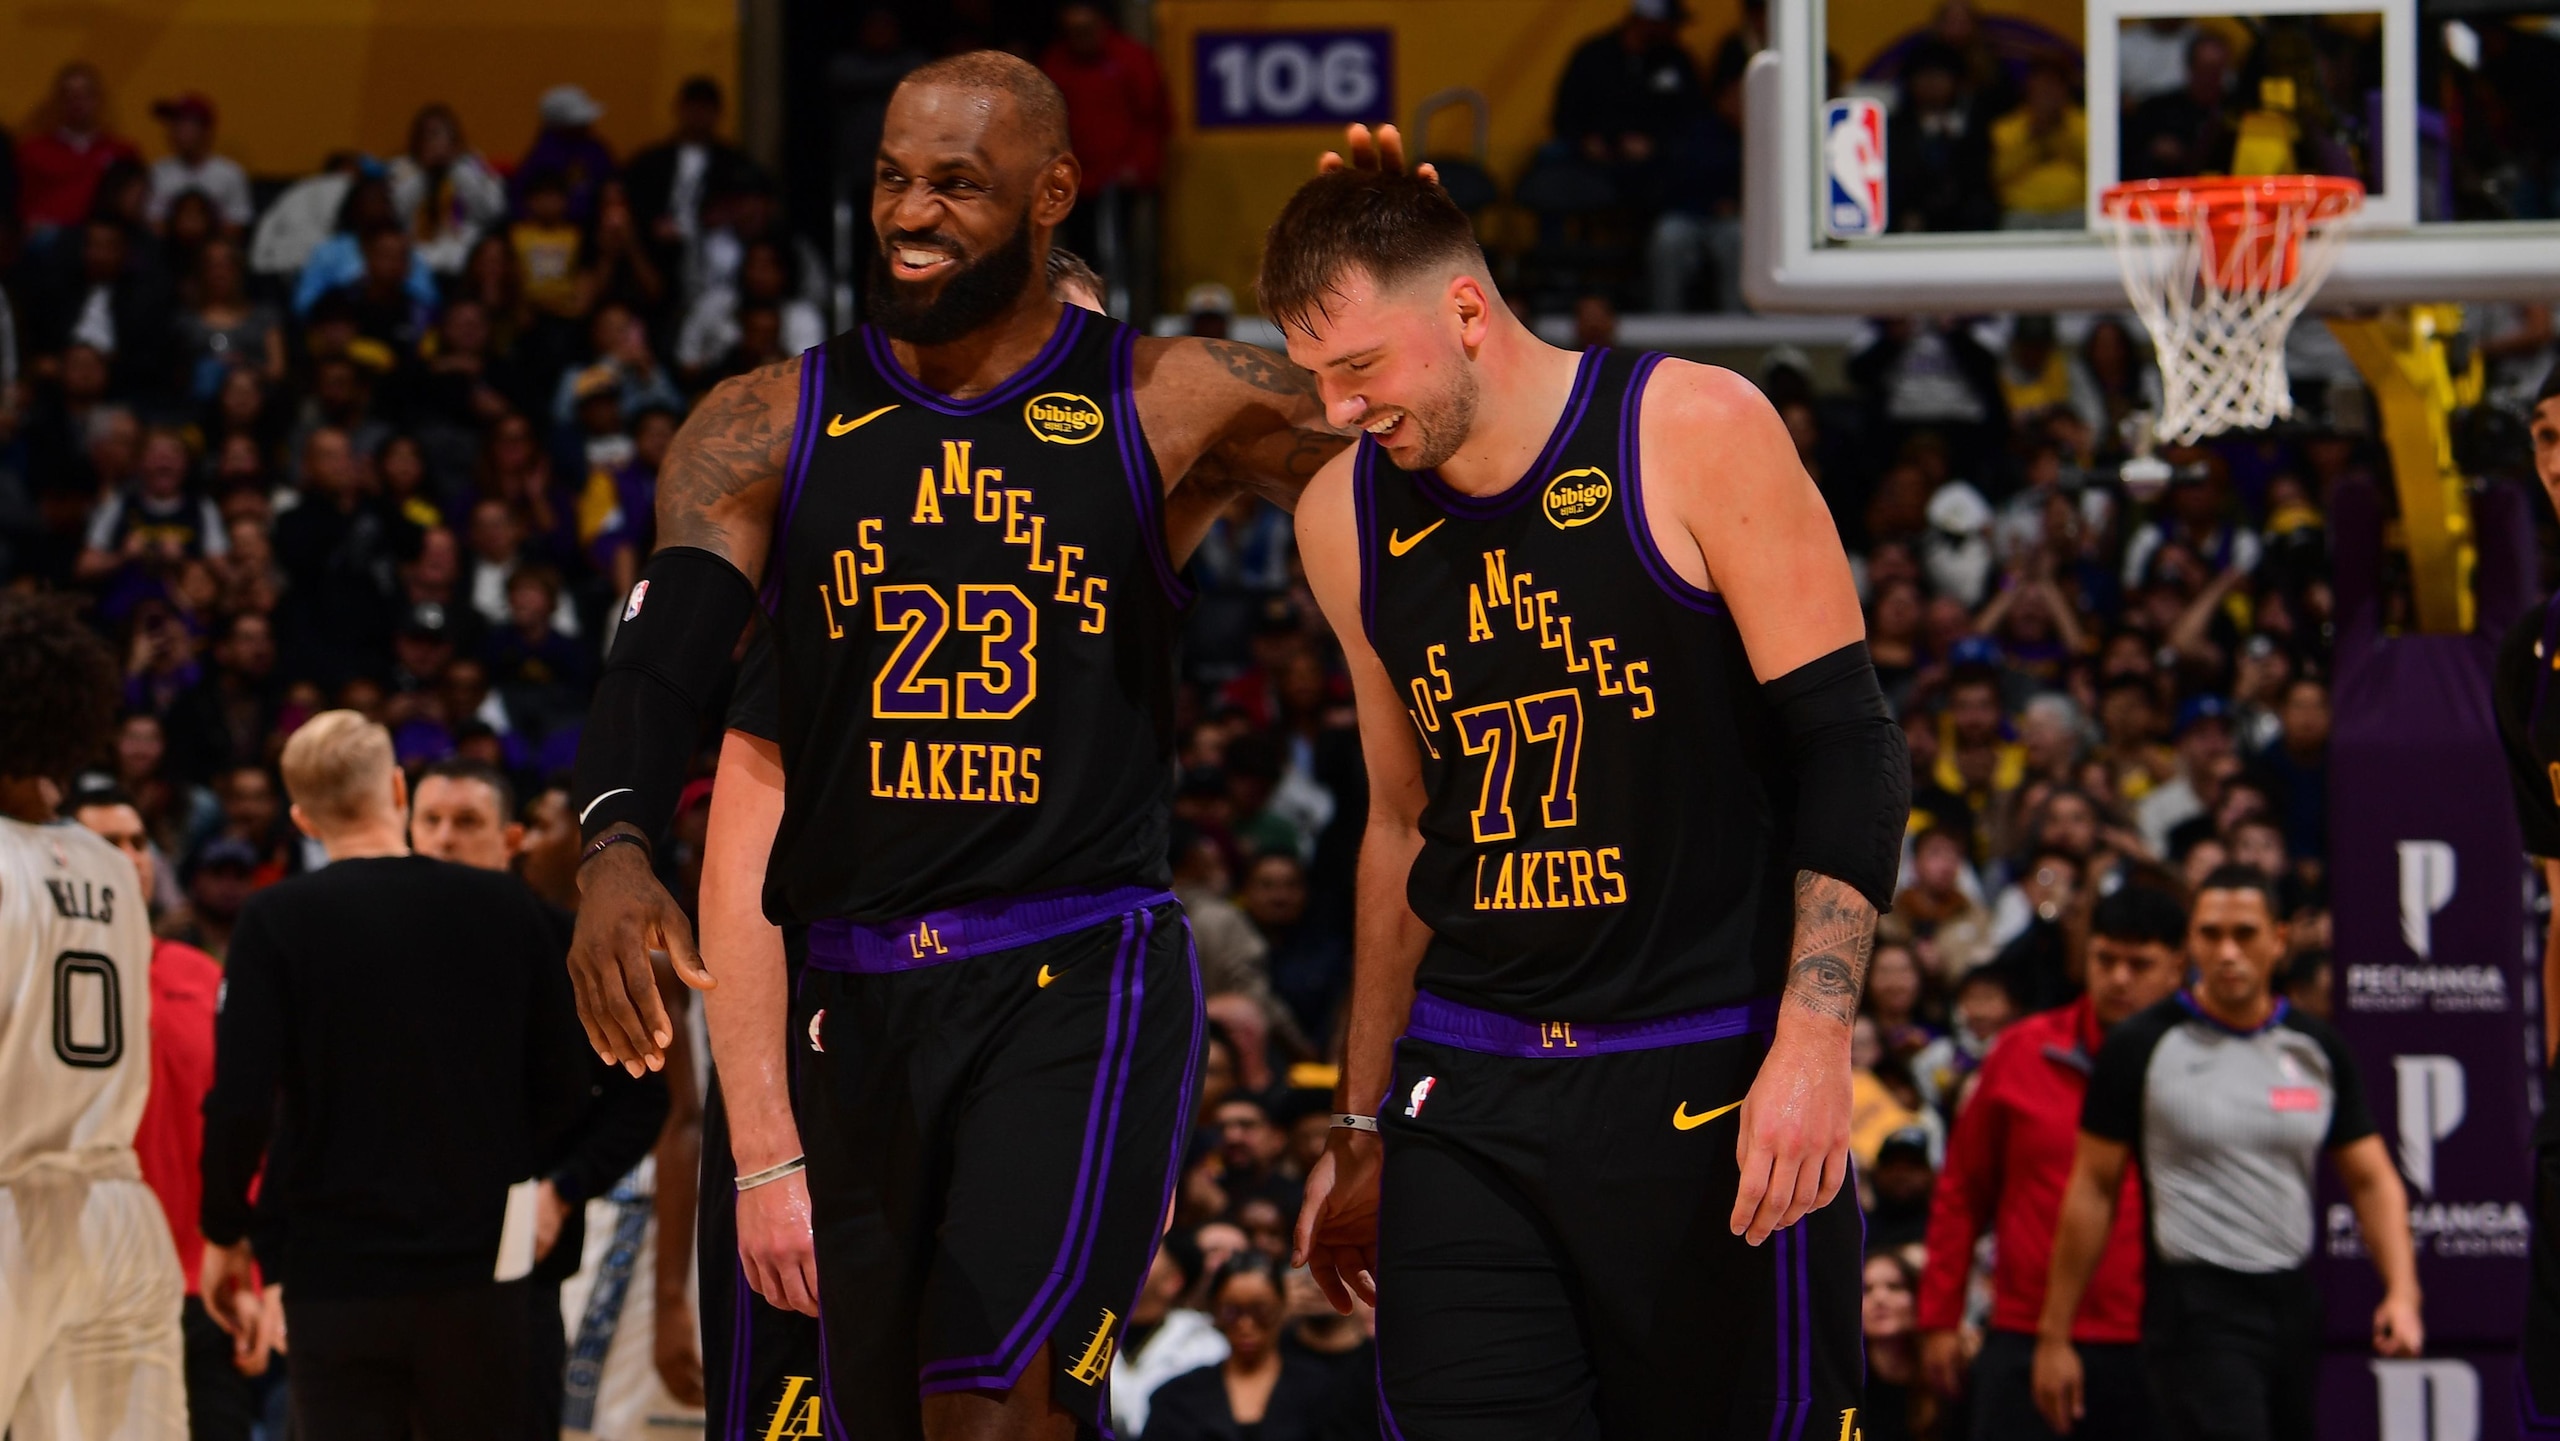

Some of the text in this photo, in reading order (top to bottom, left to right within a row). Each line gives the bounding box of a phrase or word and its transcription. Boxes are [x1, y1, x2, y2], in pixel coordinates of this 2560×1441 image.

[1209, 42, 1377, 117] 106
[1033, 404, 1098, 430] bibigo
[1549, 483, 1608, 509] bibigo
[819, 440, 1108, 639] LOS ANGELES
[873, 584, 1038, 719] 23
[1409, 549, 1655, 760] LOS ANGELES
[869, 741, 1042, 804] LAKERS
[1452, 688, 1583, 843] 77
[1474, 847, 1627, 910] LAKERS
[909, 921, 948, 958] LAL
[53, 950, 124, 1069] 0
[1540, 1021, 1577, 1048] LAL
[2326, 1202, 2529, 1235] PHANGA
